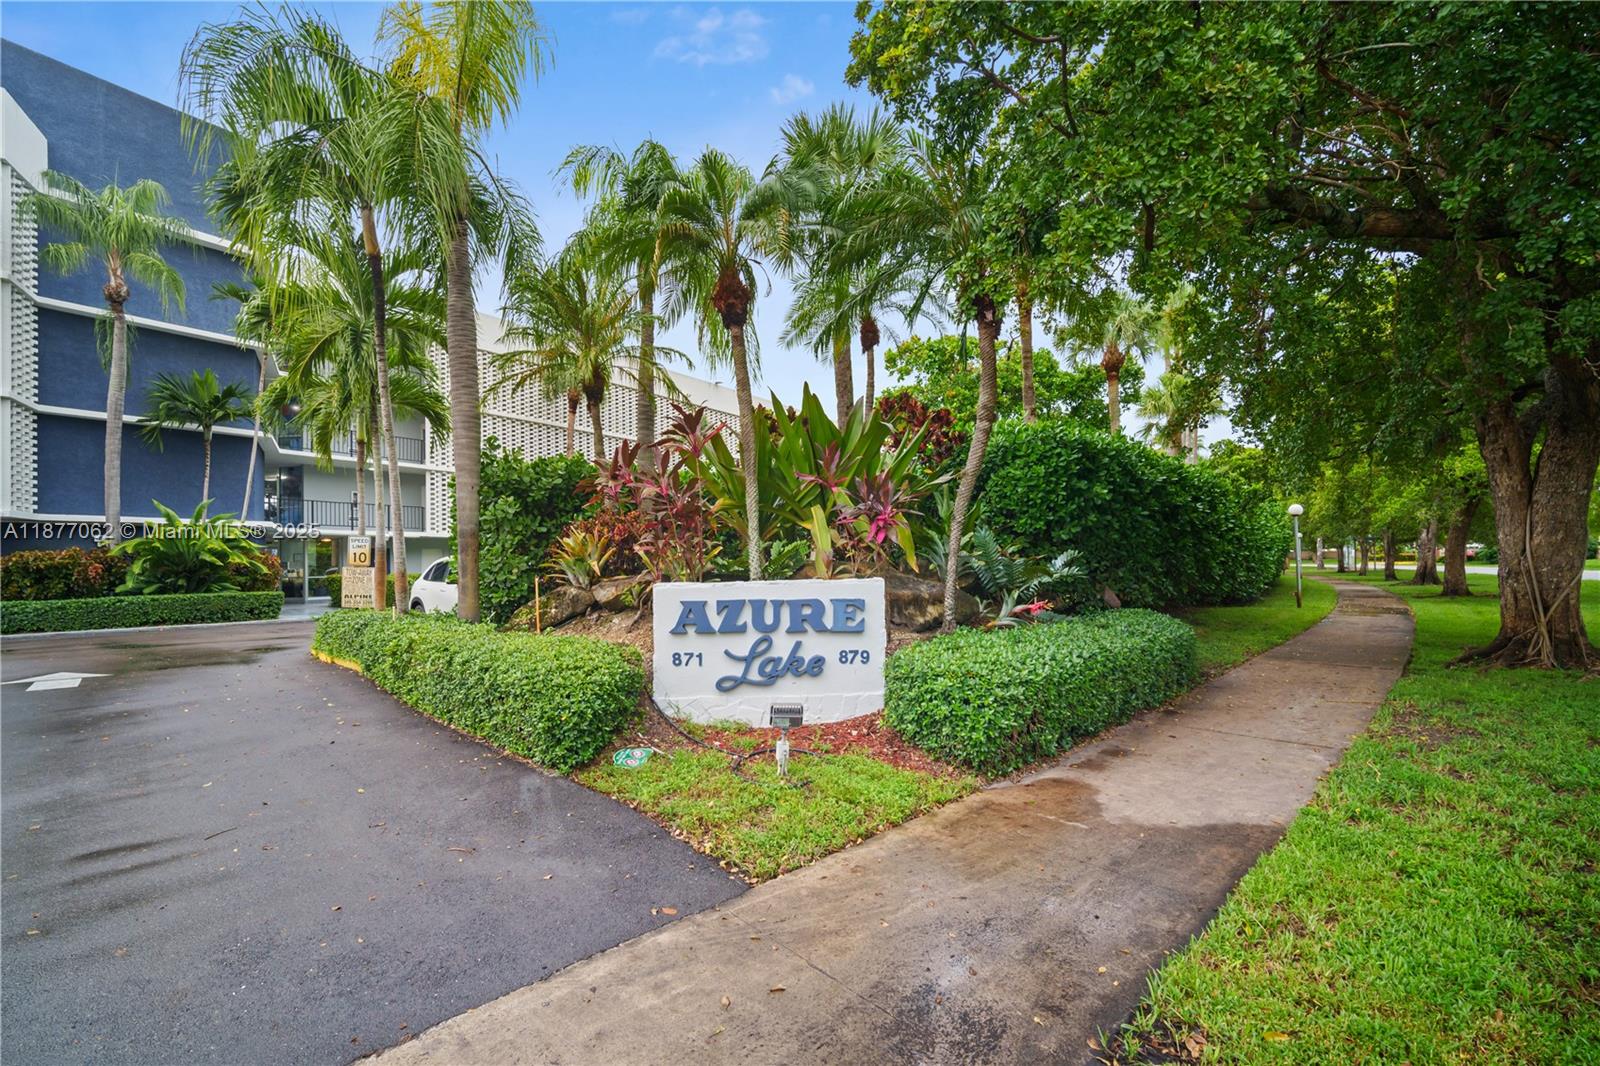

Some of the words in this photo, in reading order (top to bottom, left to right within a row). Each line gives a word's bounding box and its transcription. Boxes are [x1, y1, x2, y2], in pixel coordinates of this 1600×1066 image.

[353, 552, 367, 563] 10
[669, 598, 866, 635] AZURE
[672, 652, 704, 667] 871
[715, 635, 826, 692] Lake
[838, 650, 870, 665] 879
